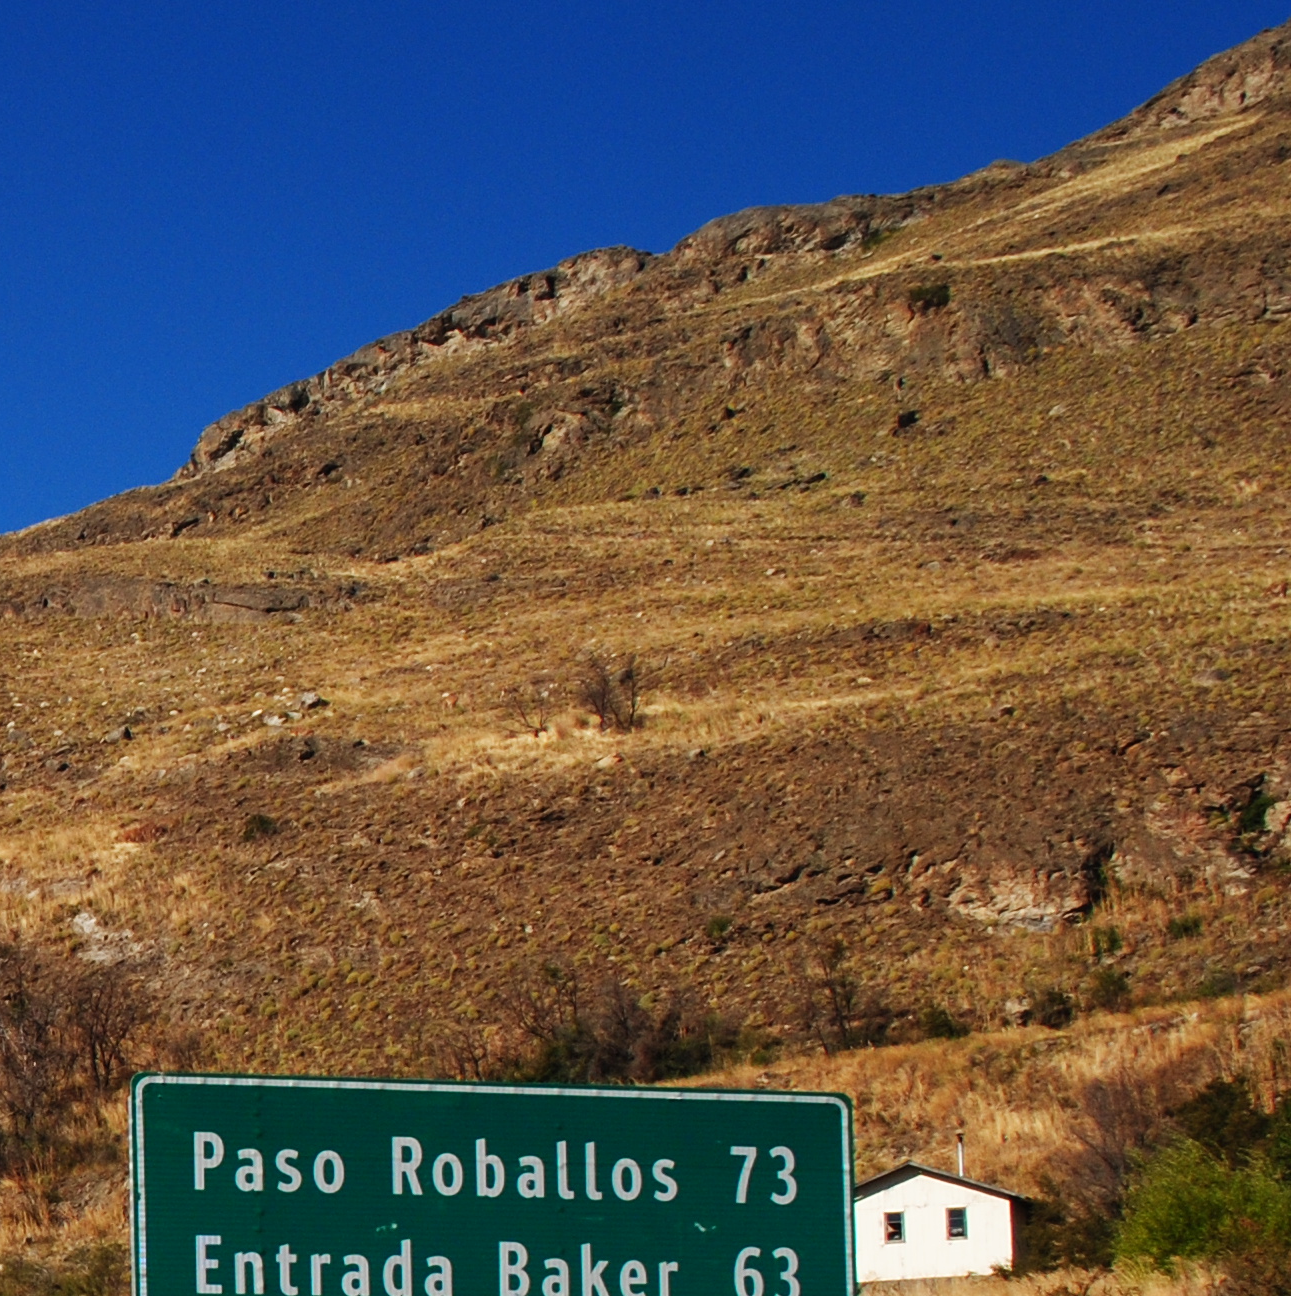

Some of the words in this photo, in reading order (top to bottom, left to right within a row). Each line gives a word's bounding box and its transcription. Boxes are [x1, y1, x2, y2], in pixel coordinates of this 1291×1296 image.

[193, 1131, 346, 1195] Paso
[391, 1136, 679, 1203] Roballos
[730, 1146, 798, 1206] 73
